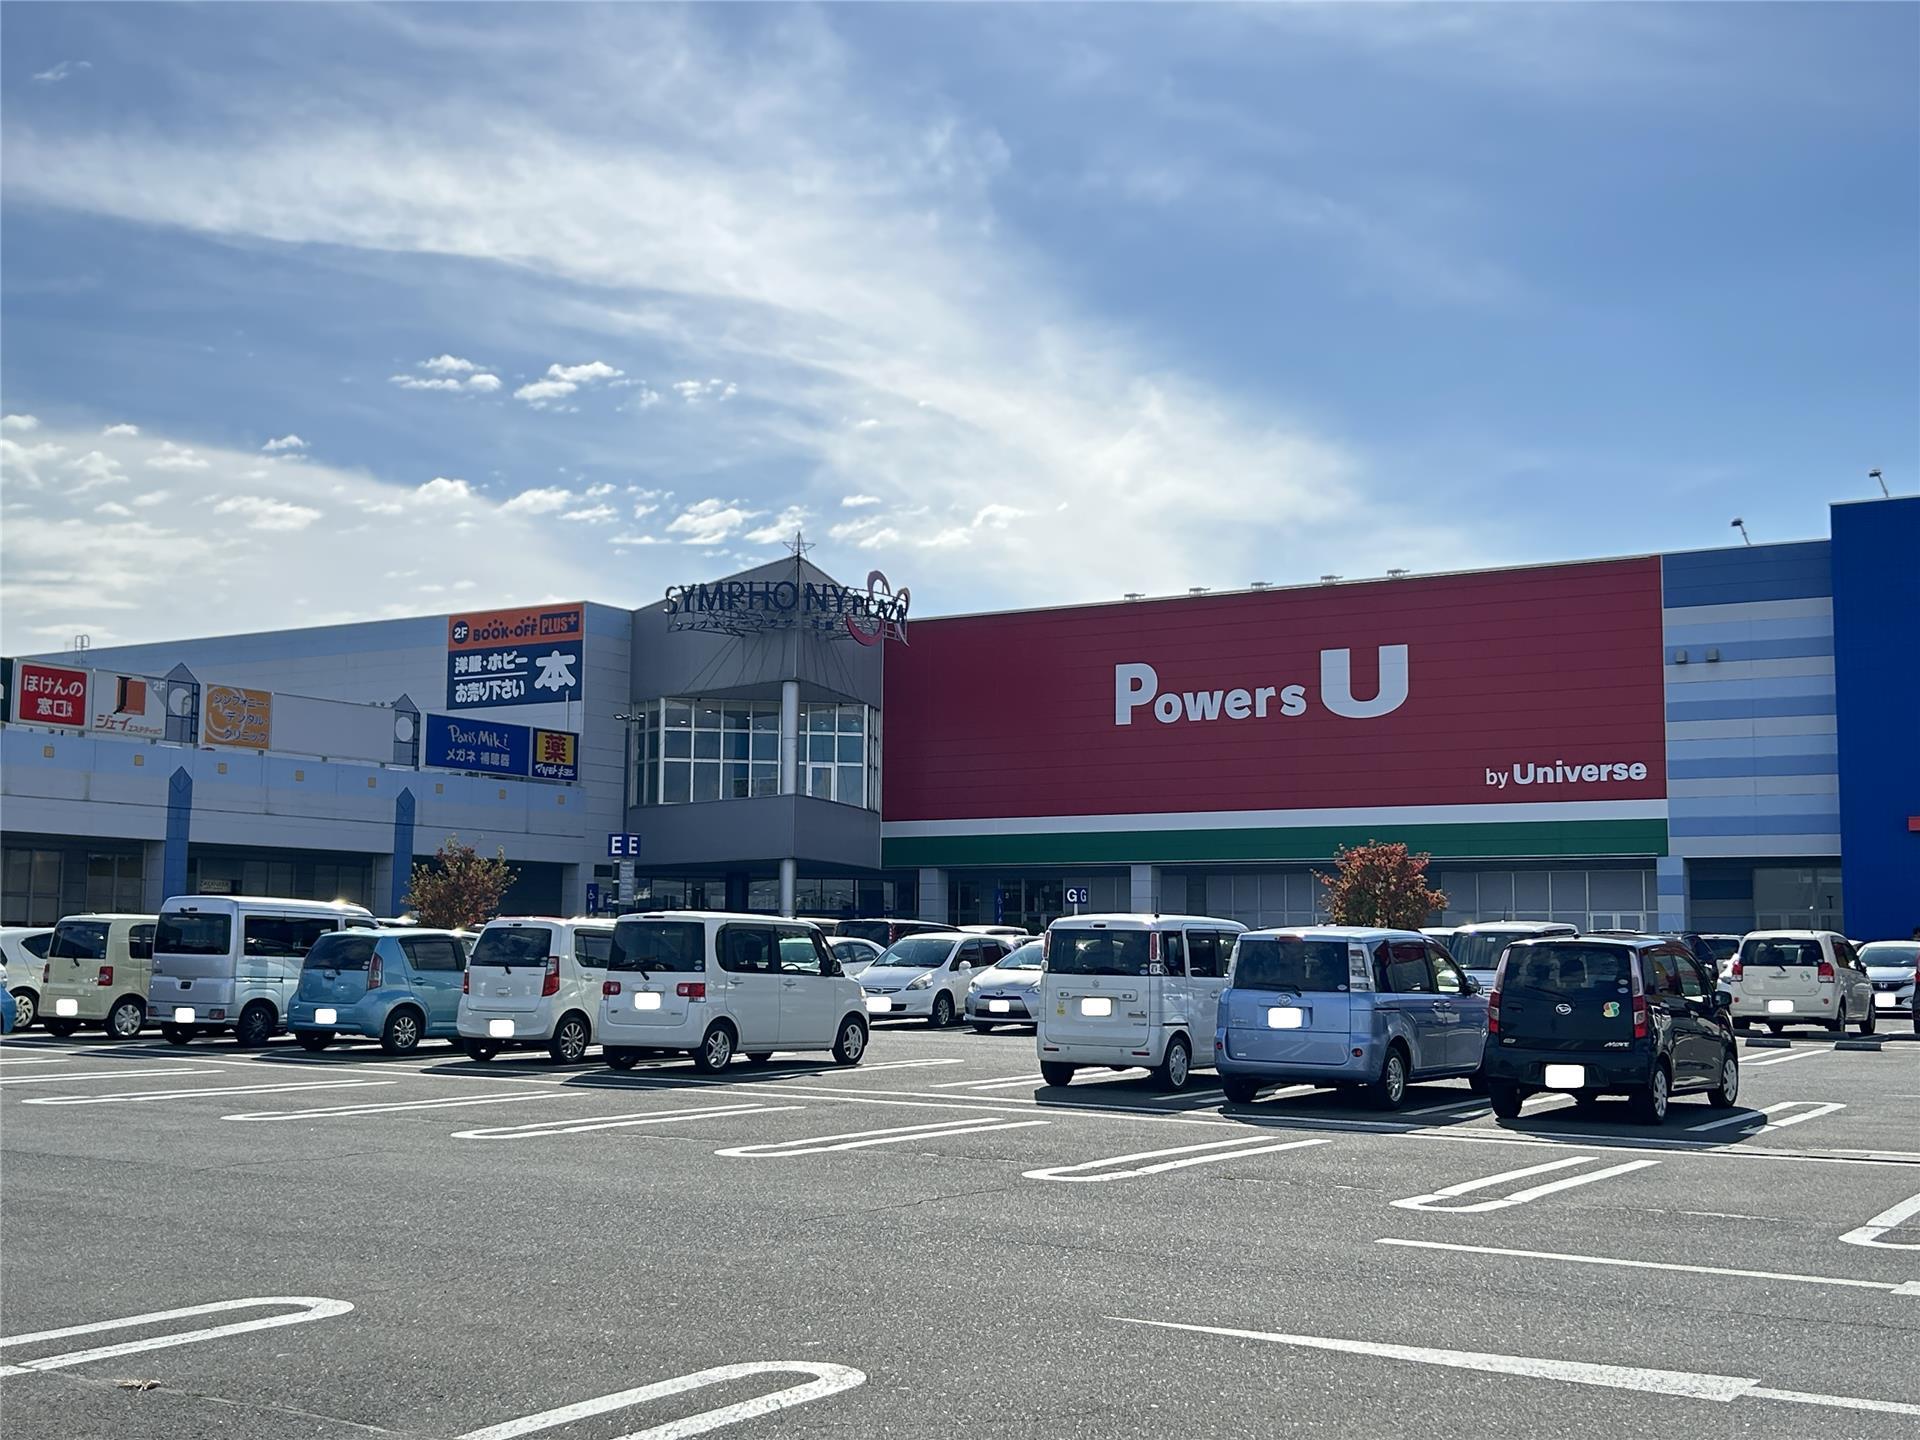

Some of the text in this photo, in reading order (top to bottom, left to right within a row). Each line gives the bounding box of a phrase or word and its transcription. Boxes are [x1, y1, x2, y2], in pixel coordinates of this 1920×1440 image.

[664, 581, 849, 614] SYMPHONY
[454, 626, 468, 639] 2F
[534, 650, 576, 692] 本
[24, 674, 84, 697] ほけんの
[153, 681, 165, 692] 2F
[455, 679, 524, 703] お売り下さい
[1115, 644, 1409, 726] Powers U
[37, 698, 69, 718] 窓口
[95, 715, 132, 731] ジェイ
[224, 729, 267, 742] クリニック
[448, 724, 510, 750] Paris Miki
[446, 748, 476, 763] メガネ
[545, 734, 566, 763] 薬
[1485, 760, 1647, 789] by Universe
[612, 836, 622, 854] E
[629, 836, 638, 854] E
[1067, 889, 1077, 902] G
[1080, 889, 1087, 902] G
